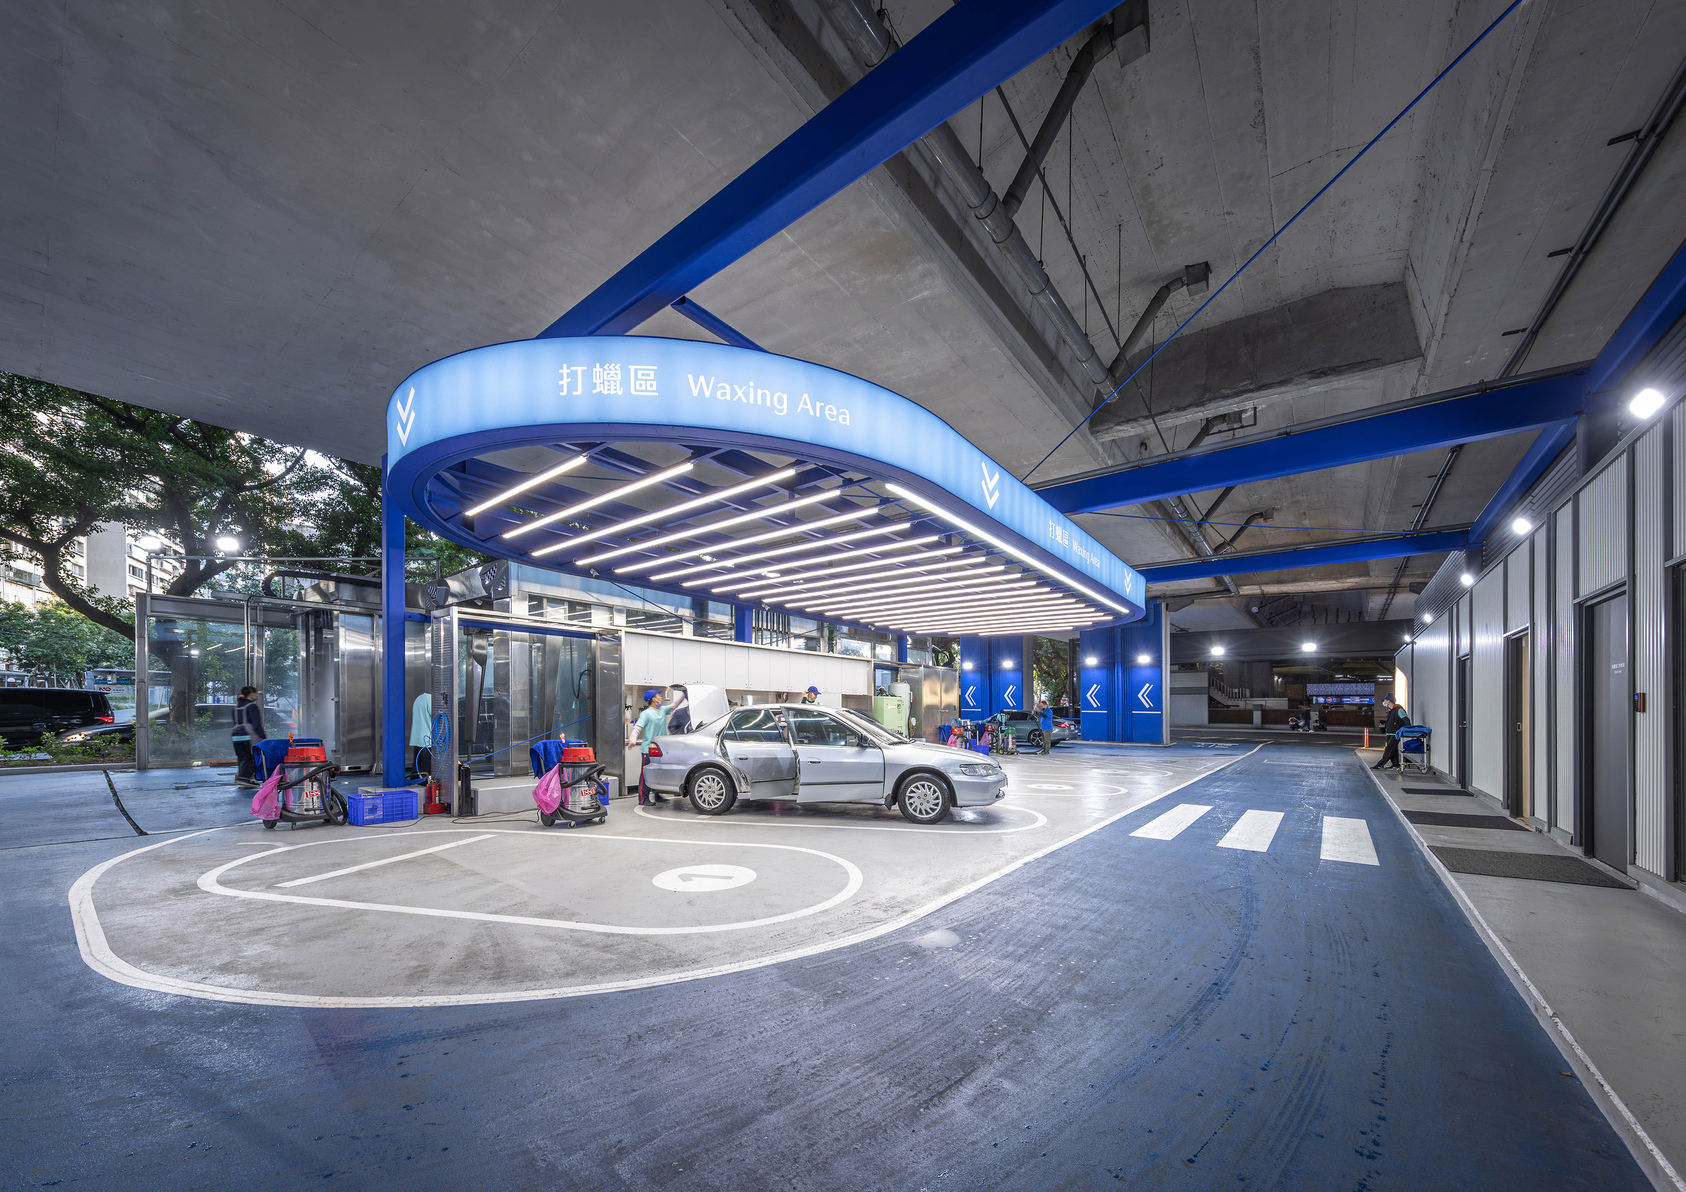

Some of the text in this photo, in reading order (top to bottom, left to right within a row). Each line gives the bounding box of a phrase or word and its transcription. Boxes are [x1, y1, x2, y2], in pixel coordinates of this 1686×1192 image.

[559, 363, 658, 396] 打蠟區
[687, 374, 851, 426] Waxing Area
[1072, 539, 1090, 564] Waxing
[677, 873, 734, 882] 1
